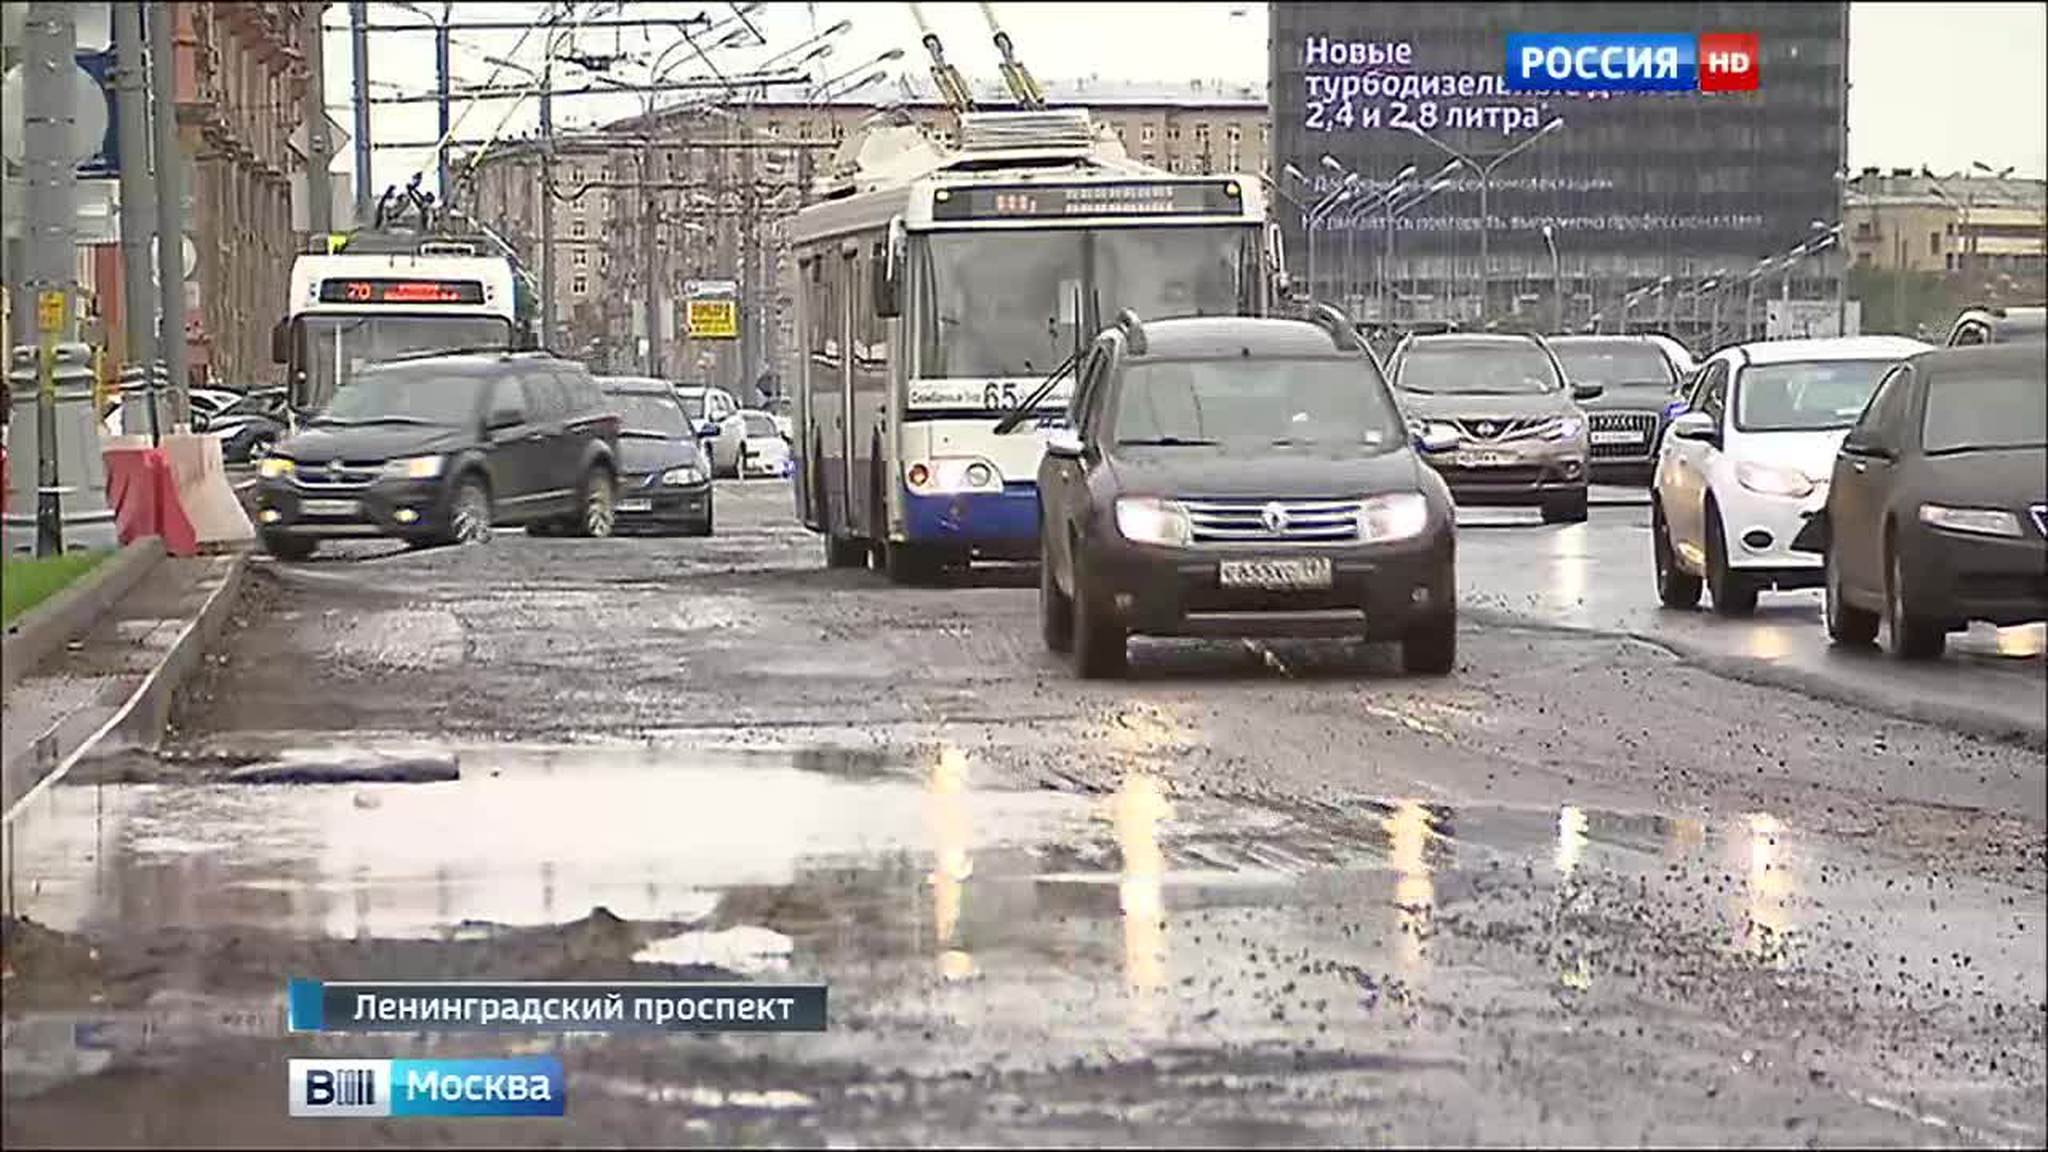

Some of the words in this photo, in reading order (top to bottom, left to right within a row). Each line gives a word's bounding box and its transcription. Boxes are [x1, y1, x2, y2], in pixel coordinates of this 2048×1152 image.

[1306, 37, 1412, 65] Новые
[1304, 70, 1580, 103] турбодизель
[1305, 102, 1354, 132] 2,4
[1362, 107, 1381, 128] и
[984, 382, 1018, 410] 65
